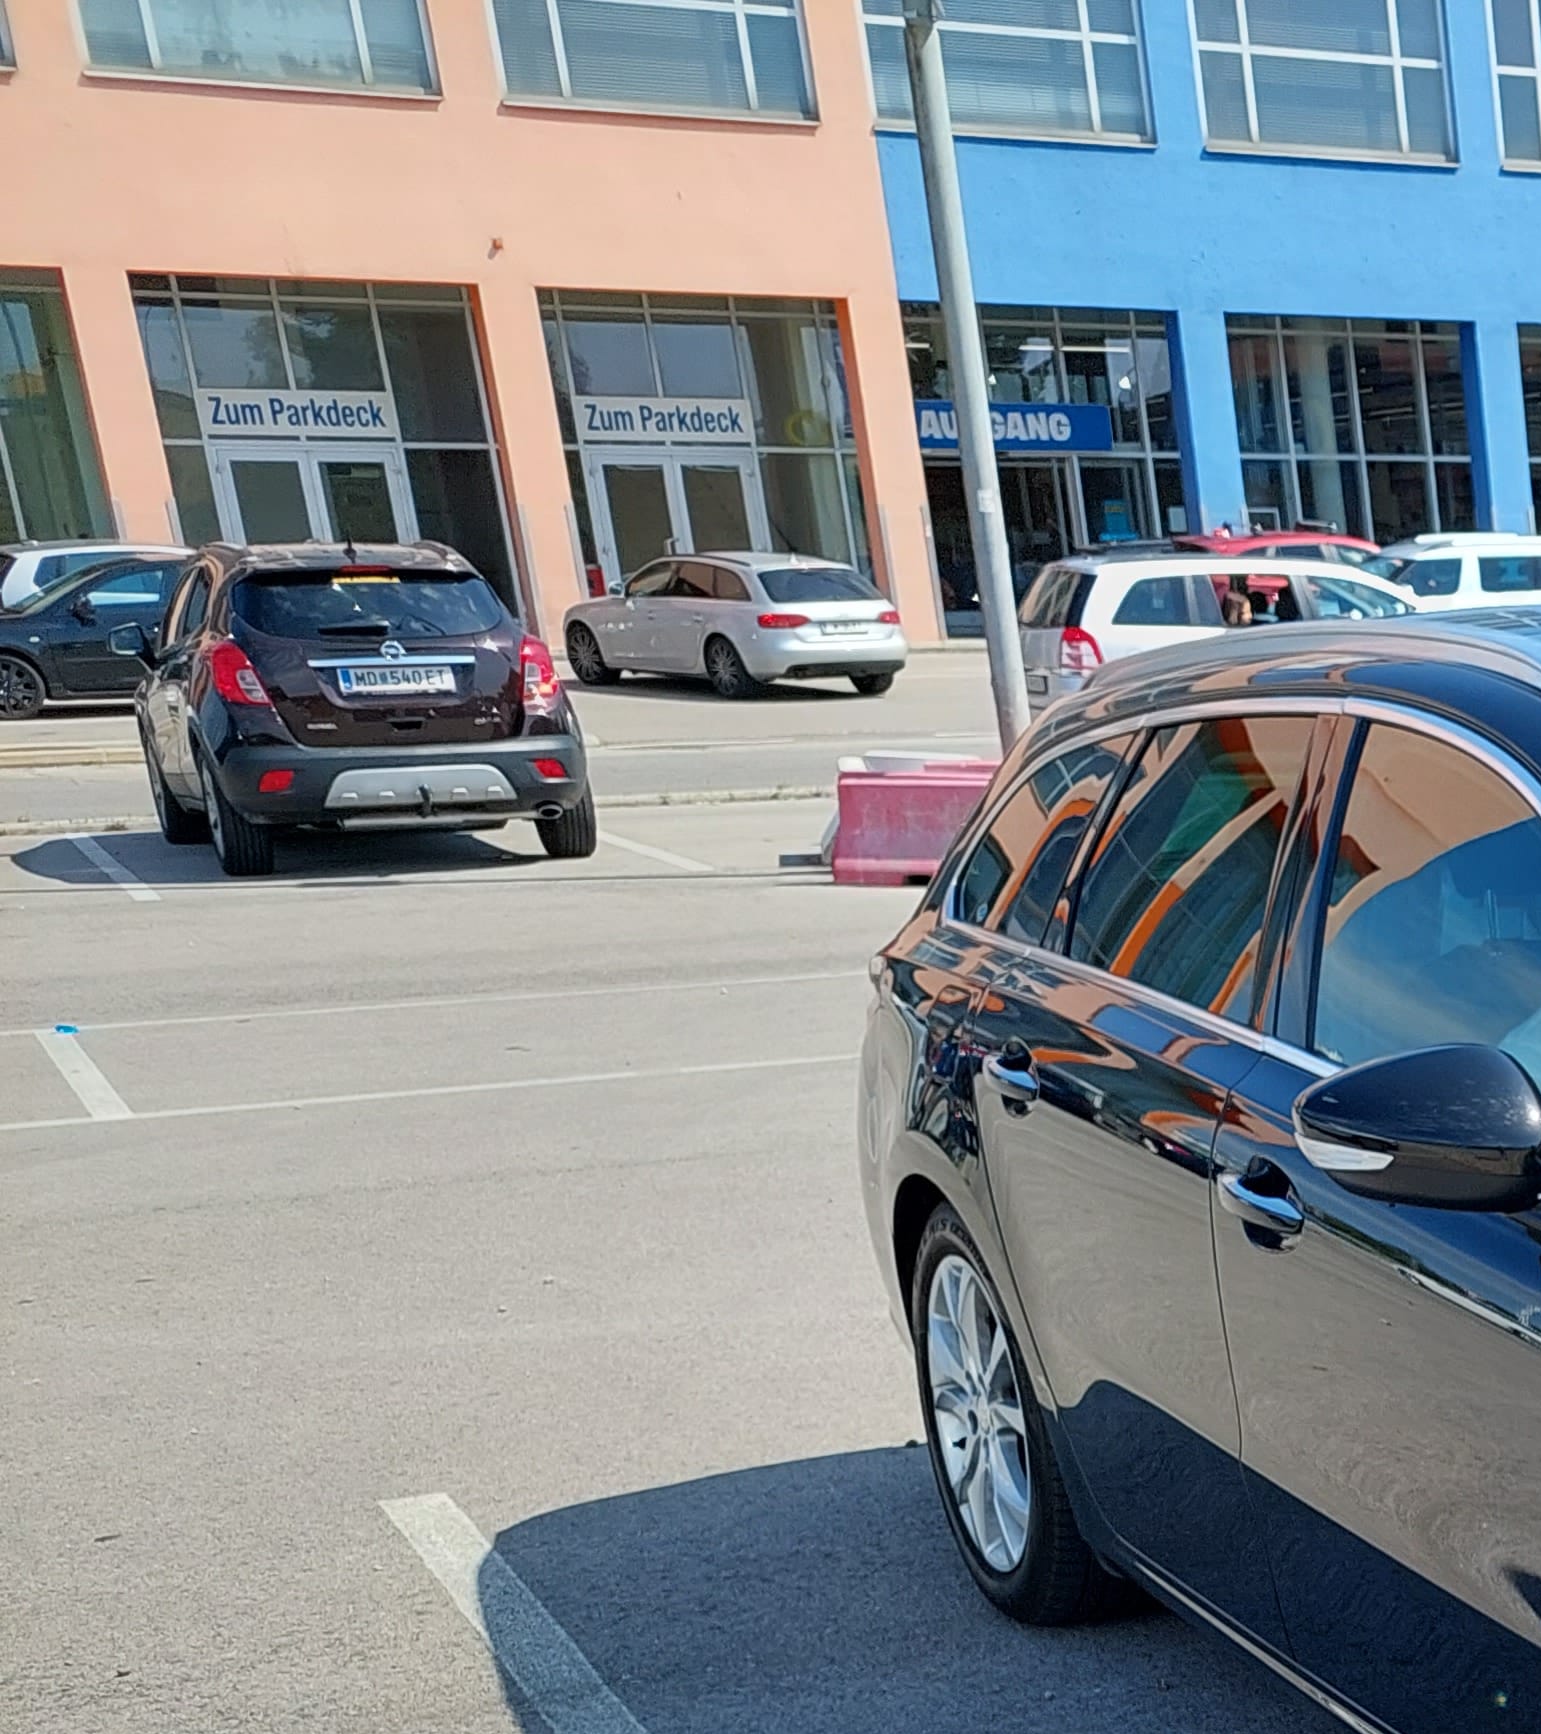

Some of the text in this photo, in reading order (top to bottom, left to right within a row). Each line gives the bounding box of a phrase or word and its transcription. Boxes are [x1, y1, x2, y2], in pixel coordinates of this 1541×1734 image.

[208, 396, 387, 428] Zum Parkdeck
[584, 403, 744, 433] Zum Parkdeck
[919, 409, 1072, 442] AUGANG
